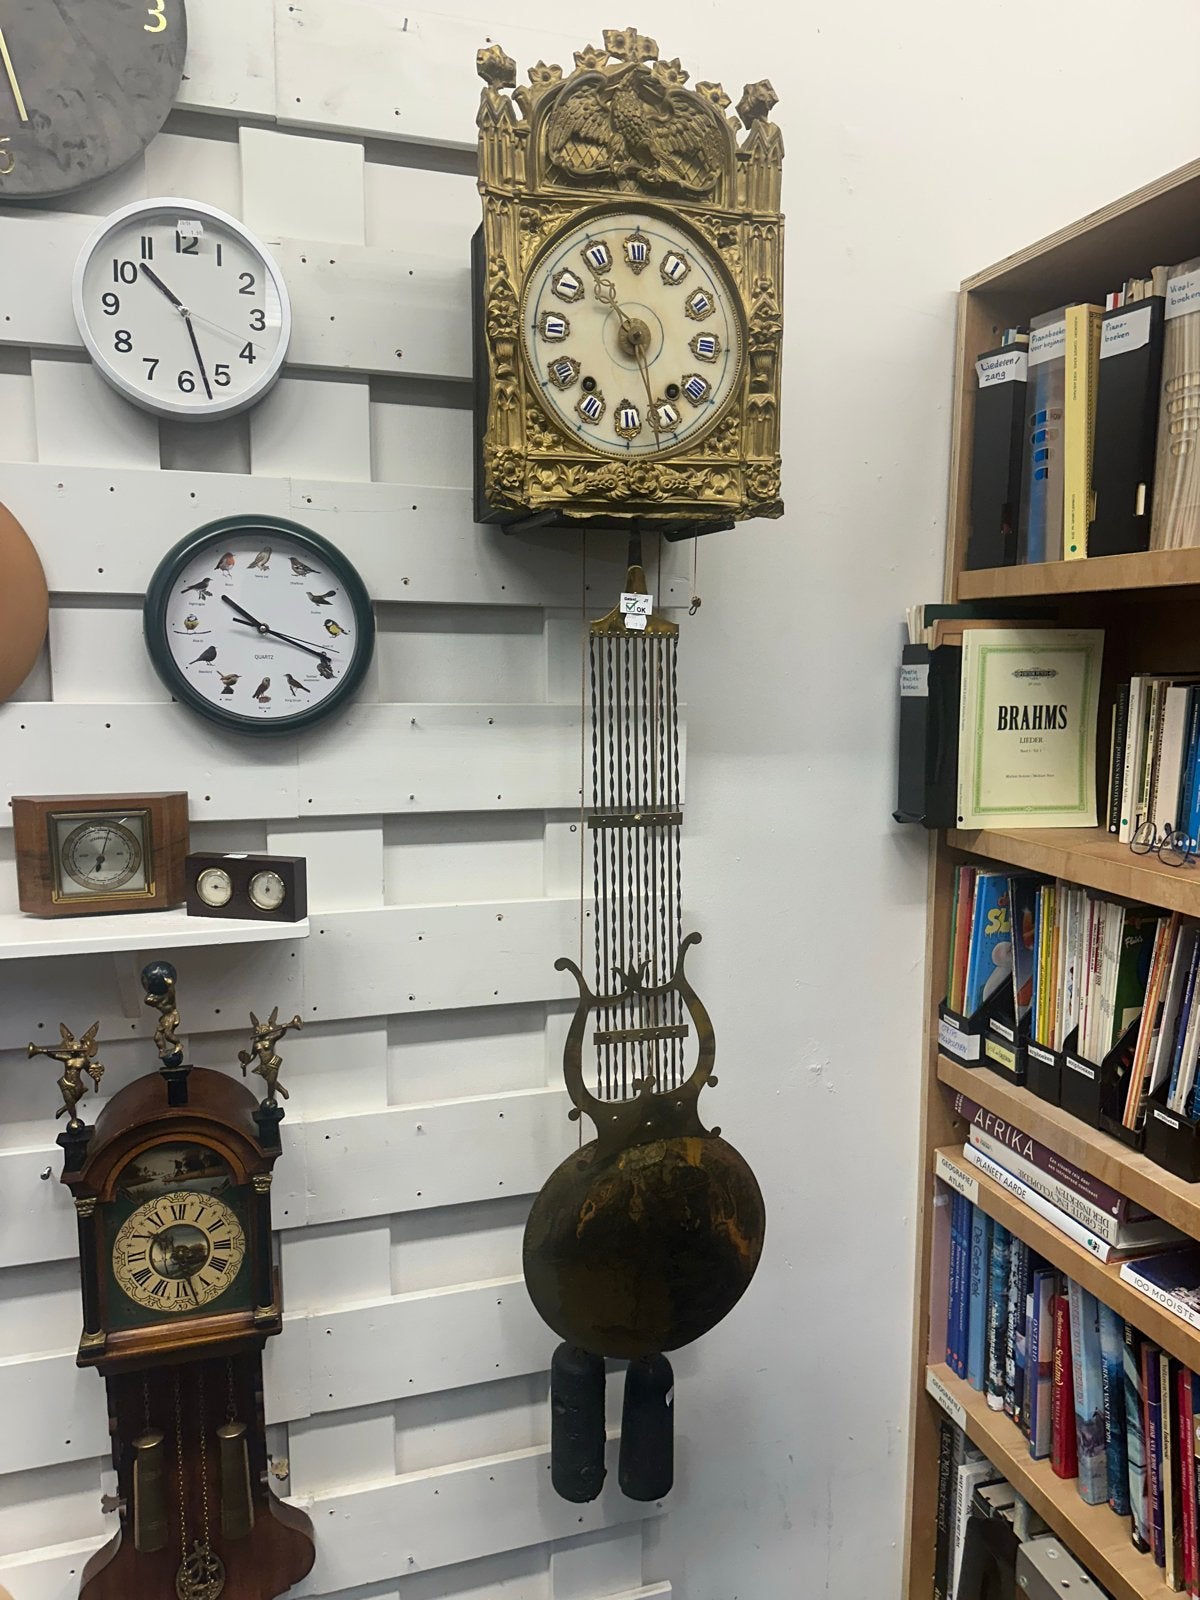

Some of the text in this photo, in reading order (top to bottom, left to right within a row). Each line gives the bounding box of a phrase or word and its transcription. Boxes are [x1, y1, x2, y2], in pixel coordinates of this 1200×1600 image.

[143, 0, 169, 33] 3
[141, 236, 154, 260] 11
[176, 230, 199, 255] 12
[216, 243, 222, 267] 1
[113, 259, 138, 284] 10
[238, 272, 256, 296] 2
[102, 292, 120, 315] 9
[249, 309, 266, 331] 3
[114, 330, 133, 353] 8
[238, 341, 257, 365] 4
[142, 358, 160, 381] 7
[177, 370, 196, 393] 6
[214, 364, 232, 387] 5
[984, 371, 1006, 381] zang
[997, 704, 1068, 731] BRAHMS
[1019, 736, 1043, 744] LIEDER
[974, 1107, 1034, 1161] AFRIKA
[941, 1158, 974, 1187] GEOGRAFIE/
[948, 1175, 965, 1192] ATLAS
[975, 1156, 1027, 1200] PLANEET AARDE
[1017, 1168, 1109, 1239] DE GROTE ENCYCLOPEDIE
[1055, 1185, 1109, 1229] DER INSEKTEN
[213, 1238, 231, 1250] III
[971, 1226, 983, 1298] De Grote Trek
[1134, 1277, 1196, 1322] 100 MOOISTE
[1056, 1310, 1064, 1338] Reflections
[1031, 1318, 1039, 1362] ONTARIO
[1054, 1346, 1064, 1386] Scotland
